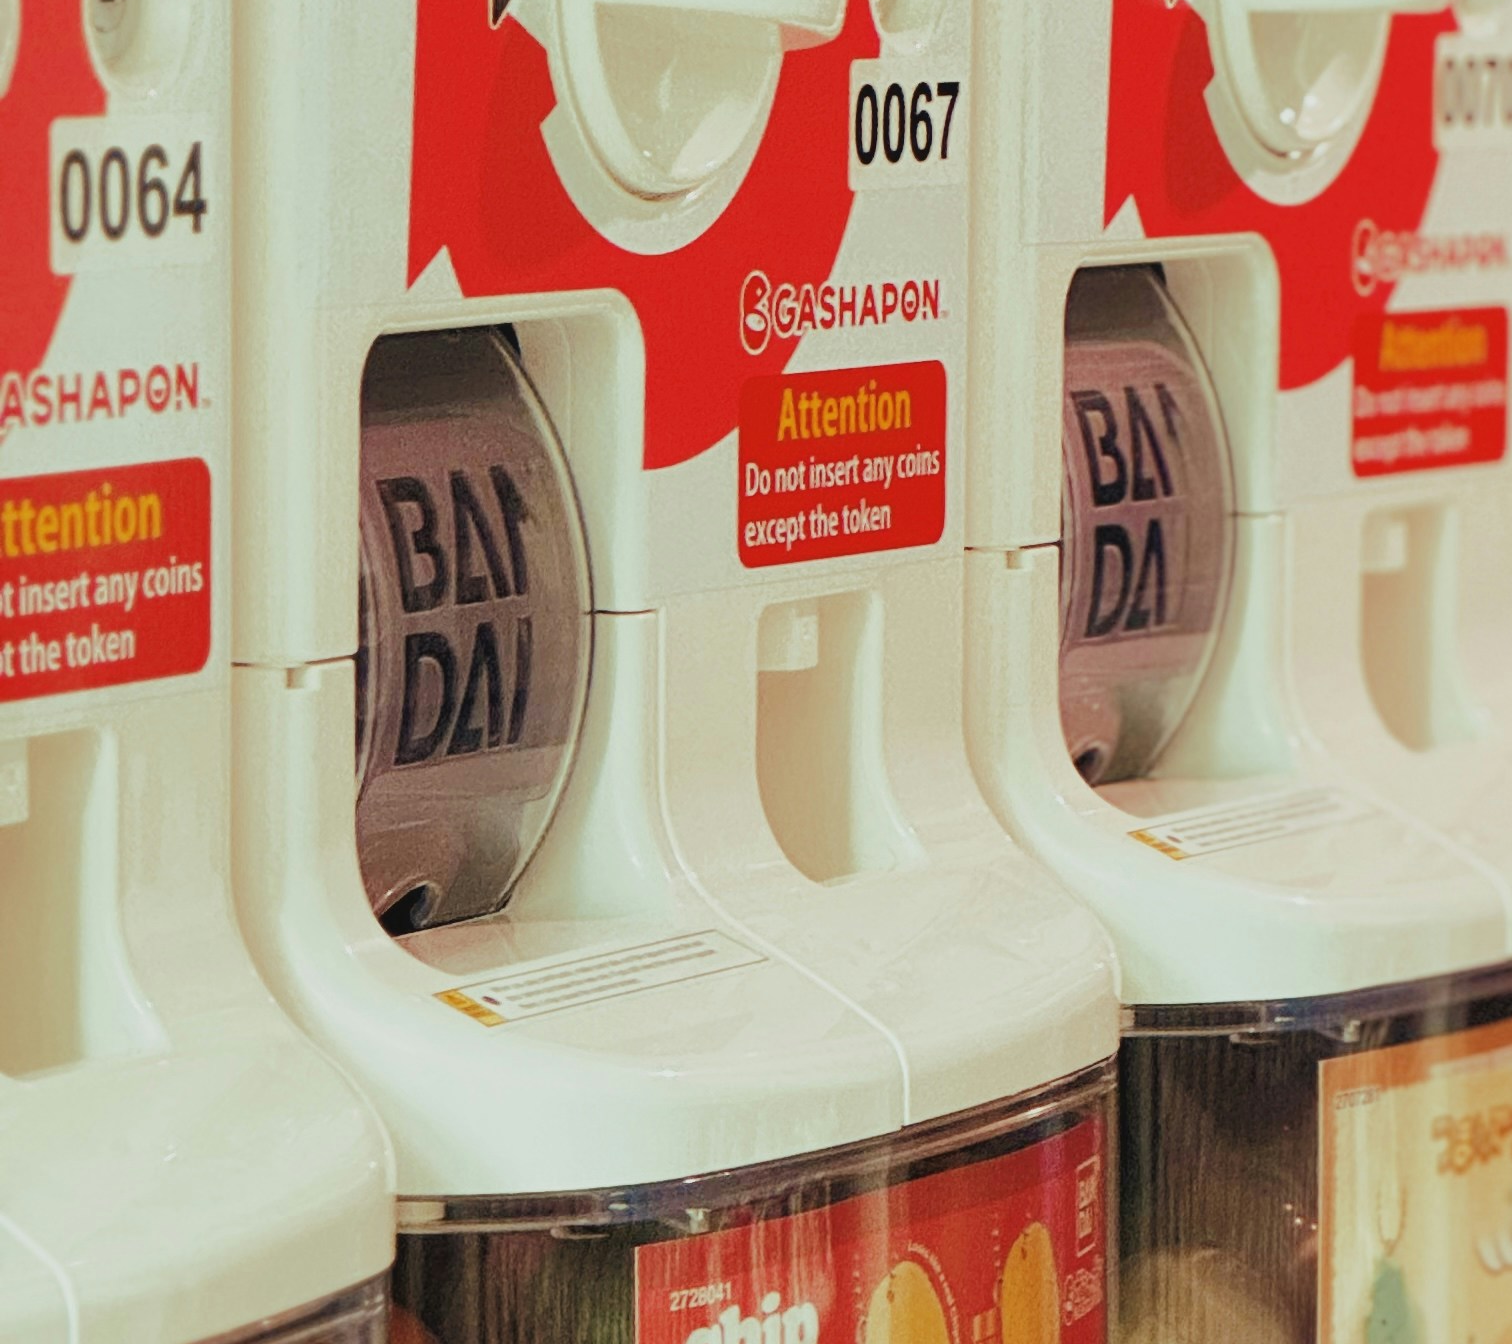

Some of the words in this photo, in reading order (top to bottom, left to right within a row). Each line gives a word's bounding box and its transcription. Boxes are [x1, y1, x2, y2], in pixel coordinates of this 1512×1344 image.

[855, 81, 960, 165] 0067
[60, 141, 208, 243] 0064
[774, 279, 939, 337] GASHAPON
[777, 379, 912, 441] Attention
[745, 462, 771, 497] Do
[775, 460, 805, 493] not
[809, 455, 859, 490] insert
[862, 454, 893, 490] any
[896, 443, 940, 479] coins
[0, 482, 162, 557] ttention
[744, 510, 805, 552] except
[809, 502, 839, 539] the
[842, 497, 892, 535] token
[19, 571, 90, 615] insert
[94, 568, 139, 612] any
[143, 556, 203, 599] coins
[19, 632, 61, 675] the
[66, 623, 136, 668] token
